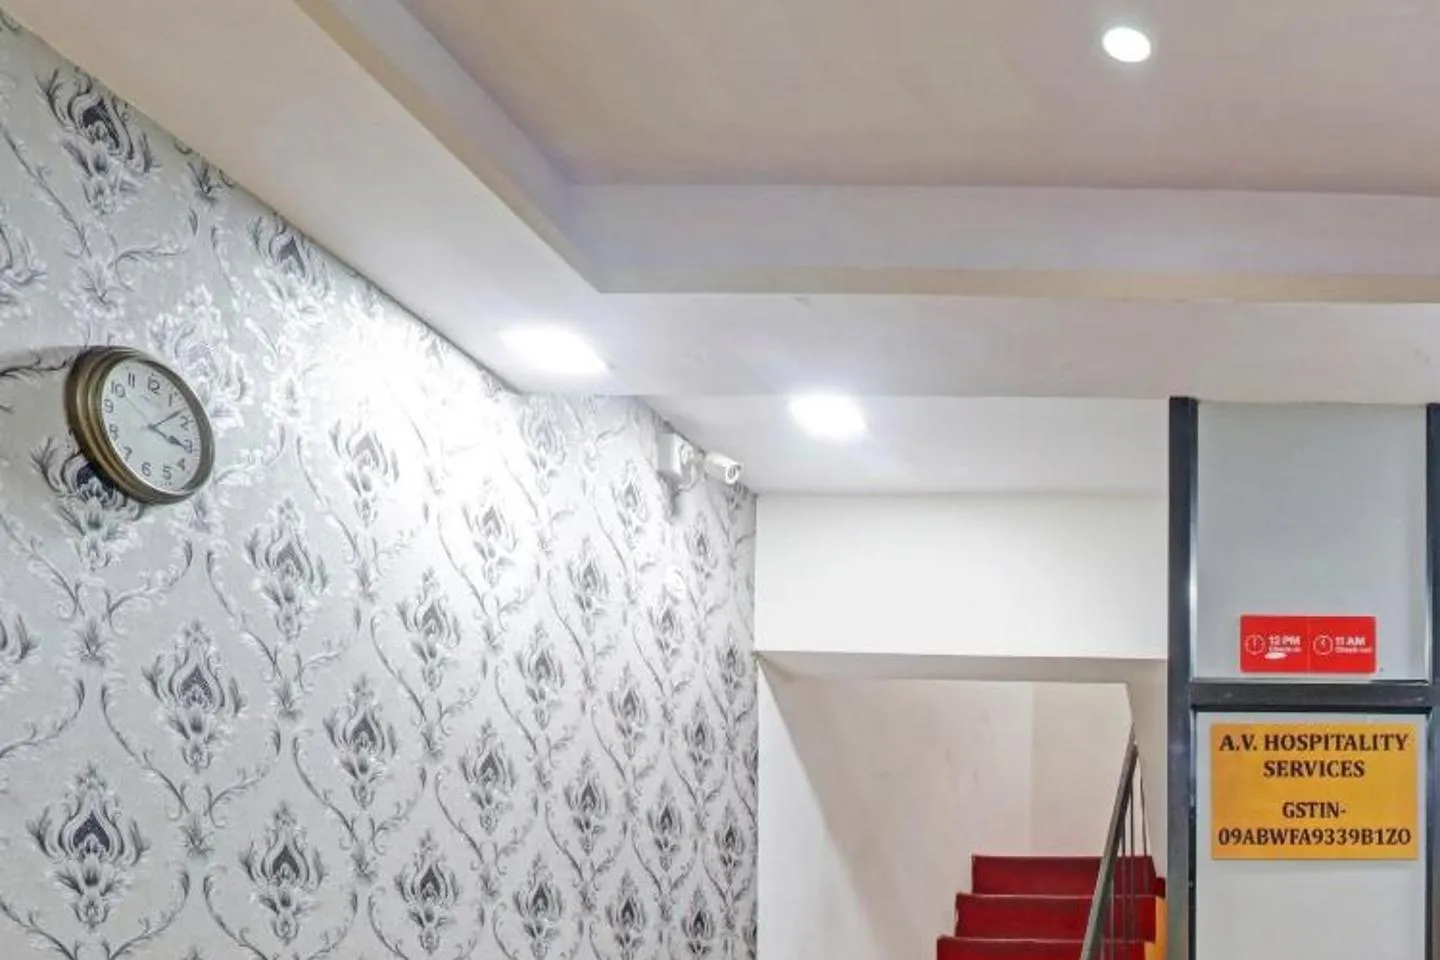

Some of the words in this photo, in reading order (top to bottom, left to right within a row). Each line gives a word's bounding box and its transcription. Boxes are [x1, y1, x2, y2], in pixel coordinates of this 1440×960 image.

[128, 372, 135, 388] 11
[147, 376, 160, 394] 12
[110, 380, 126, 398] 10
[104, 398, 114, 413] 9
[180, 415, 191, 431] 2
[109, 423, 119, 440] 8
[123, 446, 133, 462] 7
[141, 462, 152, 477] 6
[162, 465, 172, 480] 5
[177, 458, 185, 471] 4
[1282, 635, 1301, 646] PM
[1335, 636, 1344, 646] 11
[1346, 636, 1366, 646] AM
[1219, 734, 1258, 751] A.V.
[1263, 734, 1409, 751] HOSPITALITY
[1263, 760, 1365, 778] SERVICES
[1282, 801, 1347, 819] GSTIN-
